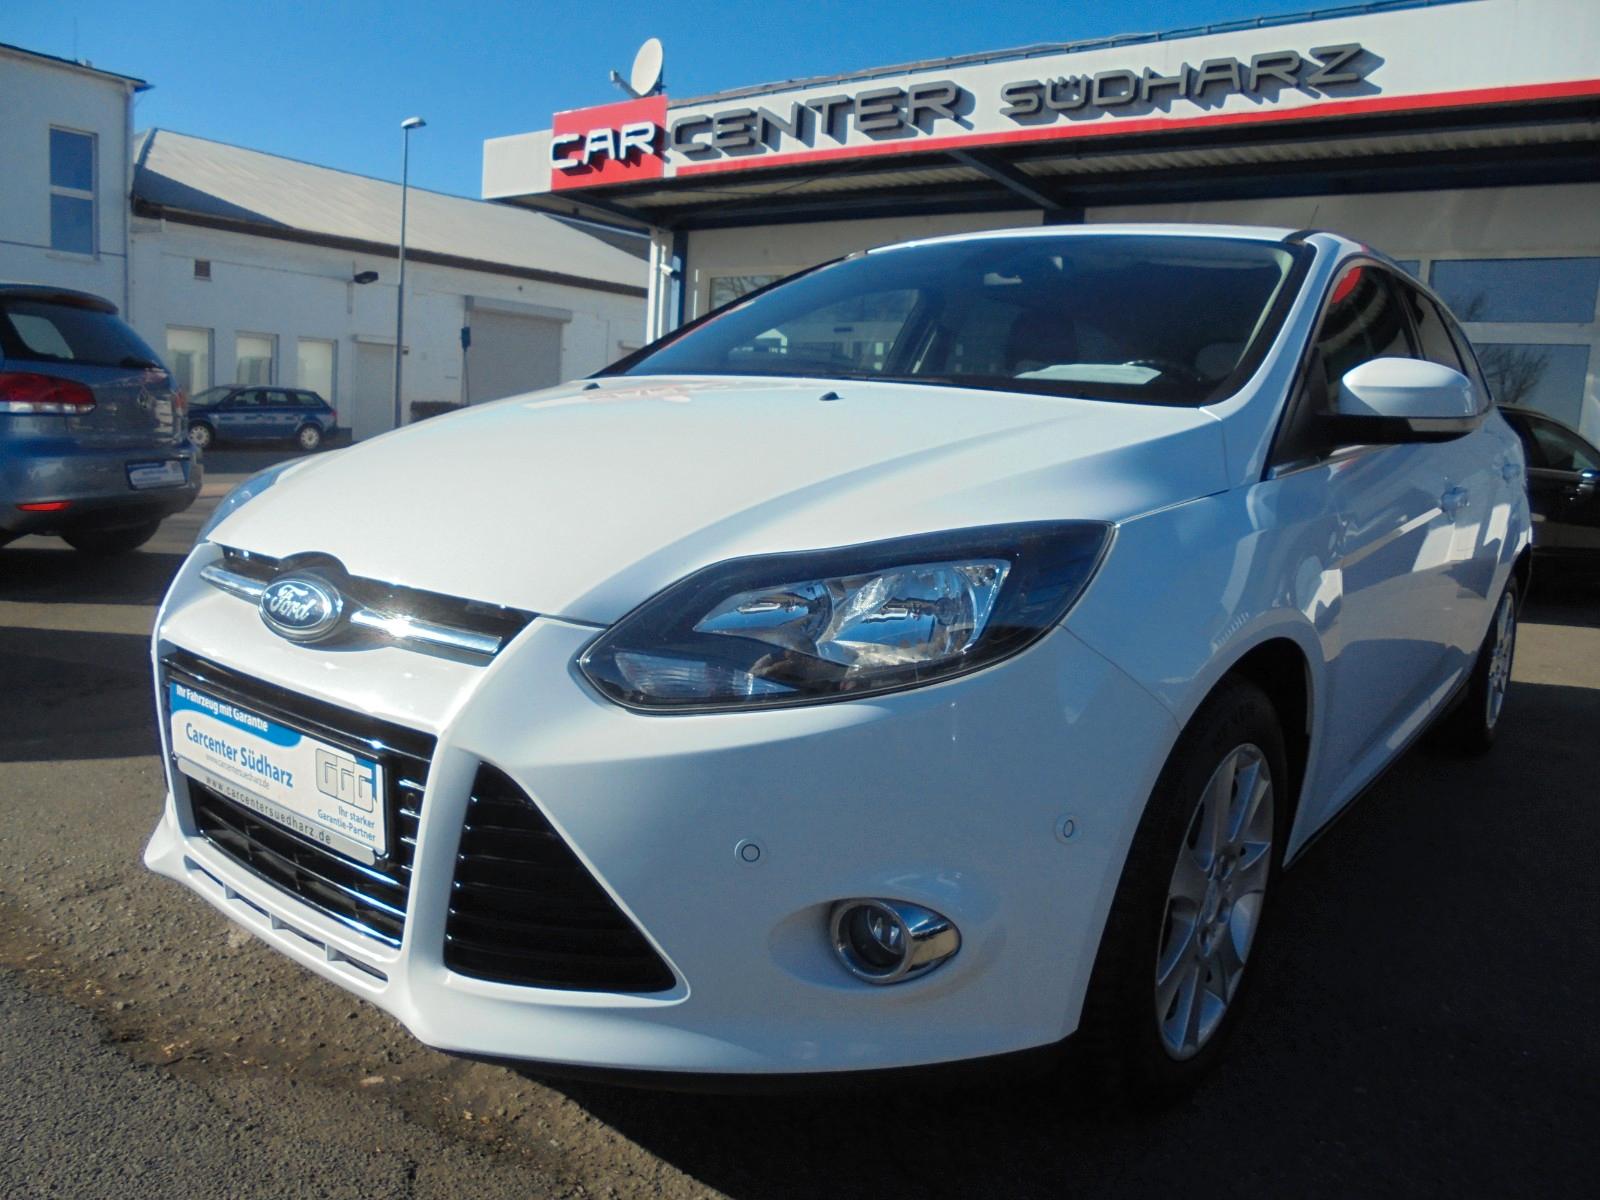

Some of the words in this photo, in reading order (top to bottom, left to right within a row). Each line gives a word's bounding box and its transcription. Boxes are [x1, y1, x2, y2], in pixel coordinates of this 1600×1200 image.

[549, 121, 657, 170] CAR
[671, 80, 960, 154] CENTER
[1000, 43, 1363, 117] SÜDHARZ
[270, 584, 317, 621] Ford
[176, 684, 187, 698] Ihr
[187, 688, 219, 715] Fahrzeug
[219, 702, 233, 718] mit
[233, 708, 269, 732] Garantie
[185, 721, 238, 762] Carcenter
[240, 746, 294, 788] Südharz
[206, 776, 331, 844] www.carcentersuedharz.de
[317, 809, 376, 841] Garantie-Partner
[338, 805, 349, 817] Ihr
[349, 812, 375, 828] starker
